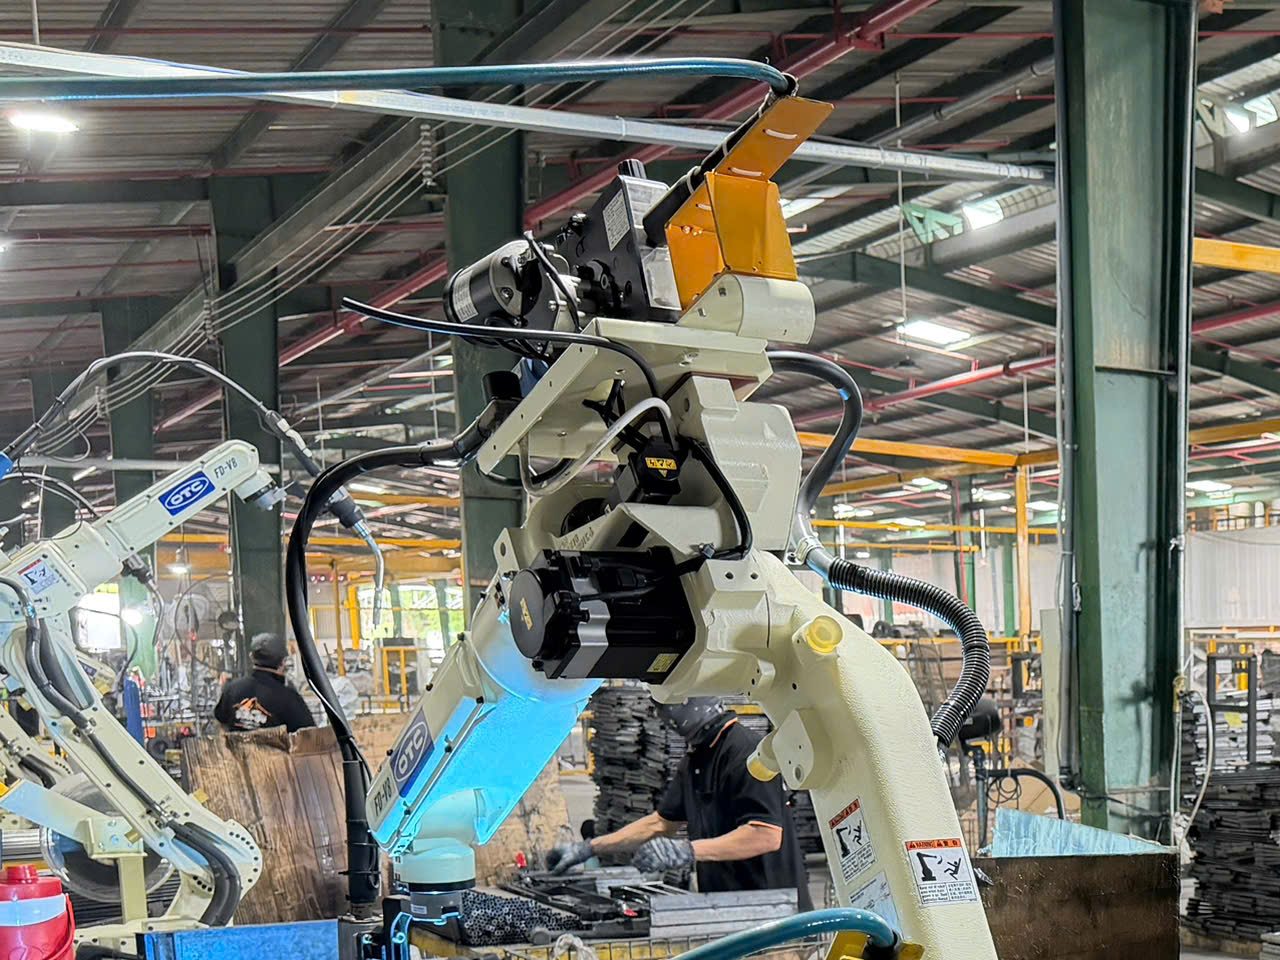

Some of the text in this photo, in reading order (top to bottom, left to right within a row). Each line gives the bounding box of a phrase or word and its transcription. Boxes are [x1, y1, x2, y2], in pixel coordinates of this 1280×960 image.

[171, 457, 238, 505] OTC FD-V8
[398, 728, 423, 775] OTC
